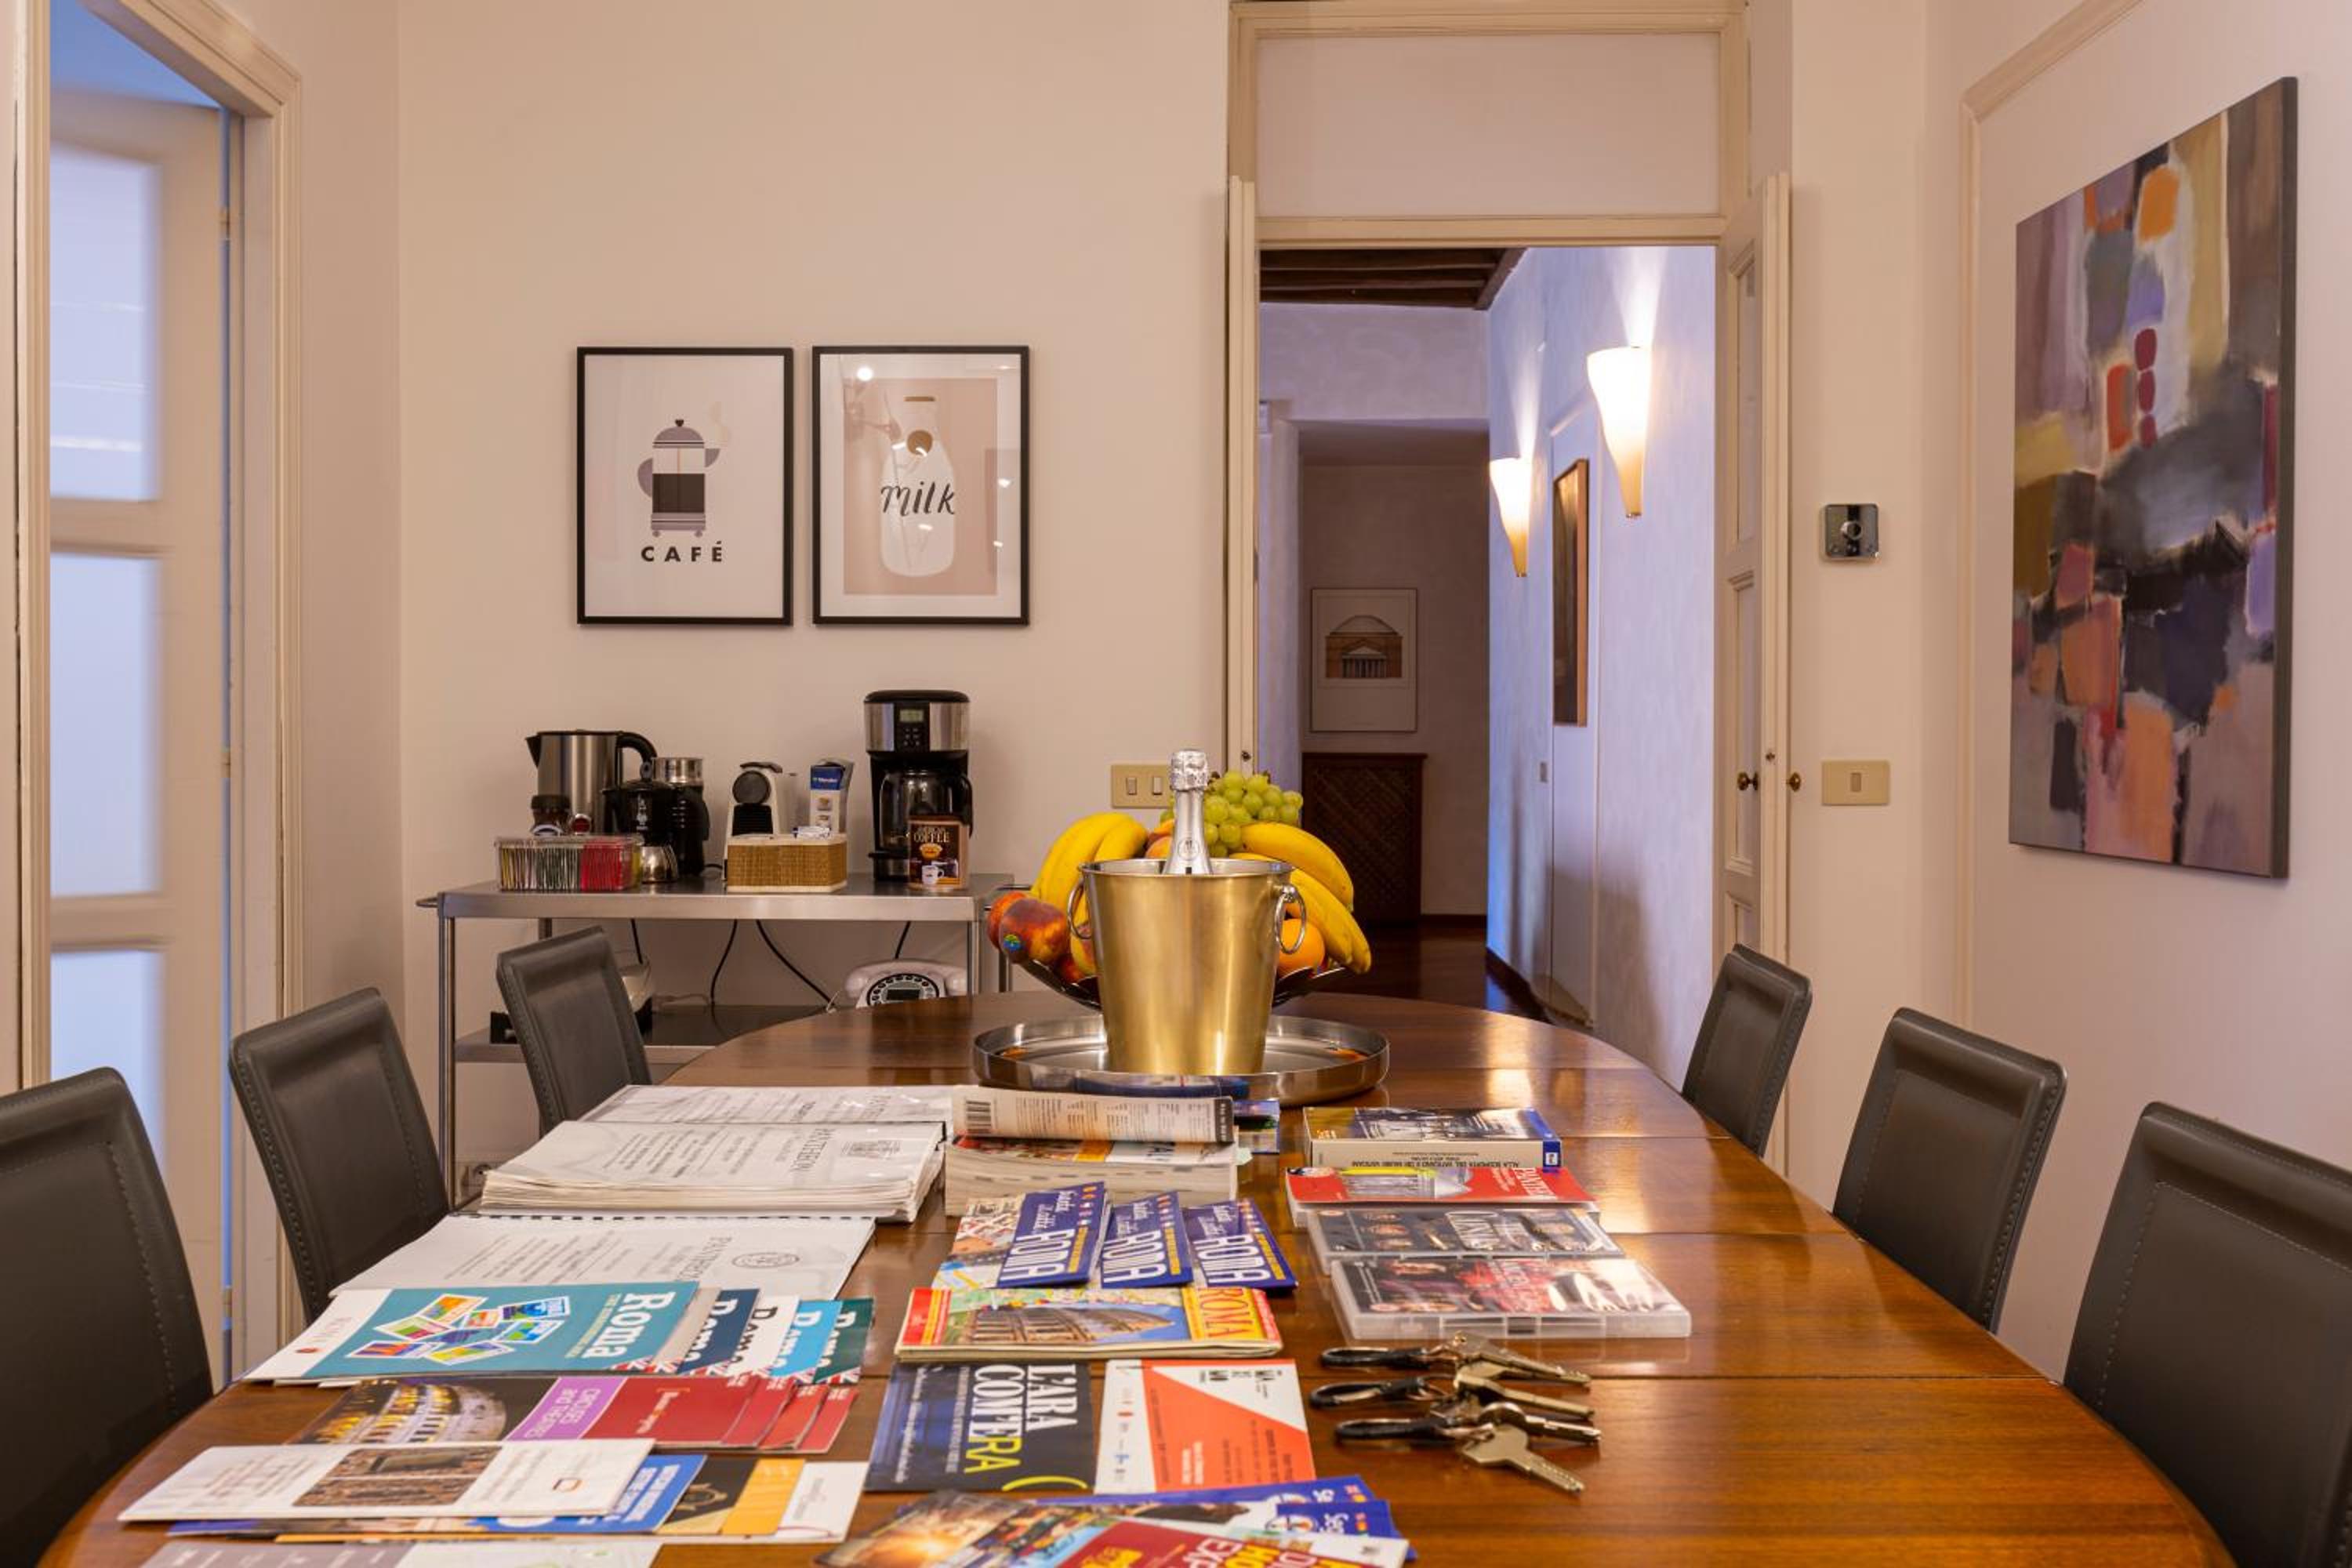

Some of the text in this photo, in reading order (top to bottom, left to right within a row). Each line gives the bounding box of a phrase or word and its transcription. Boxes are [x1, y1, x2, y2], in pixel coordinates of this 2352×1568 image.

[880, 481, 956, 516] milk
[641, 541, 723, 562] CAFÉ
[1000, 1229, 1076, 1281] ROMA
[1103, 1230, 1167, 1283] ROMA
[1192, 1234, 1271, 1283] ROMA
[581, 1291, 677, 1359] Roma
[1199, 1287, 1254, 1338] ROMA
